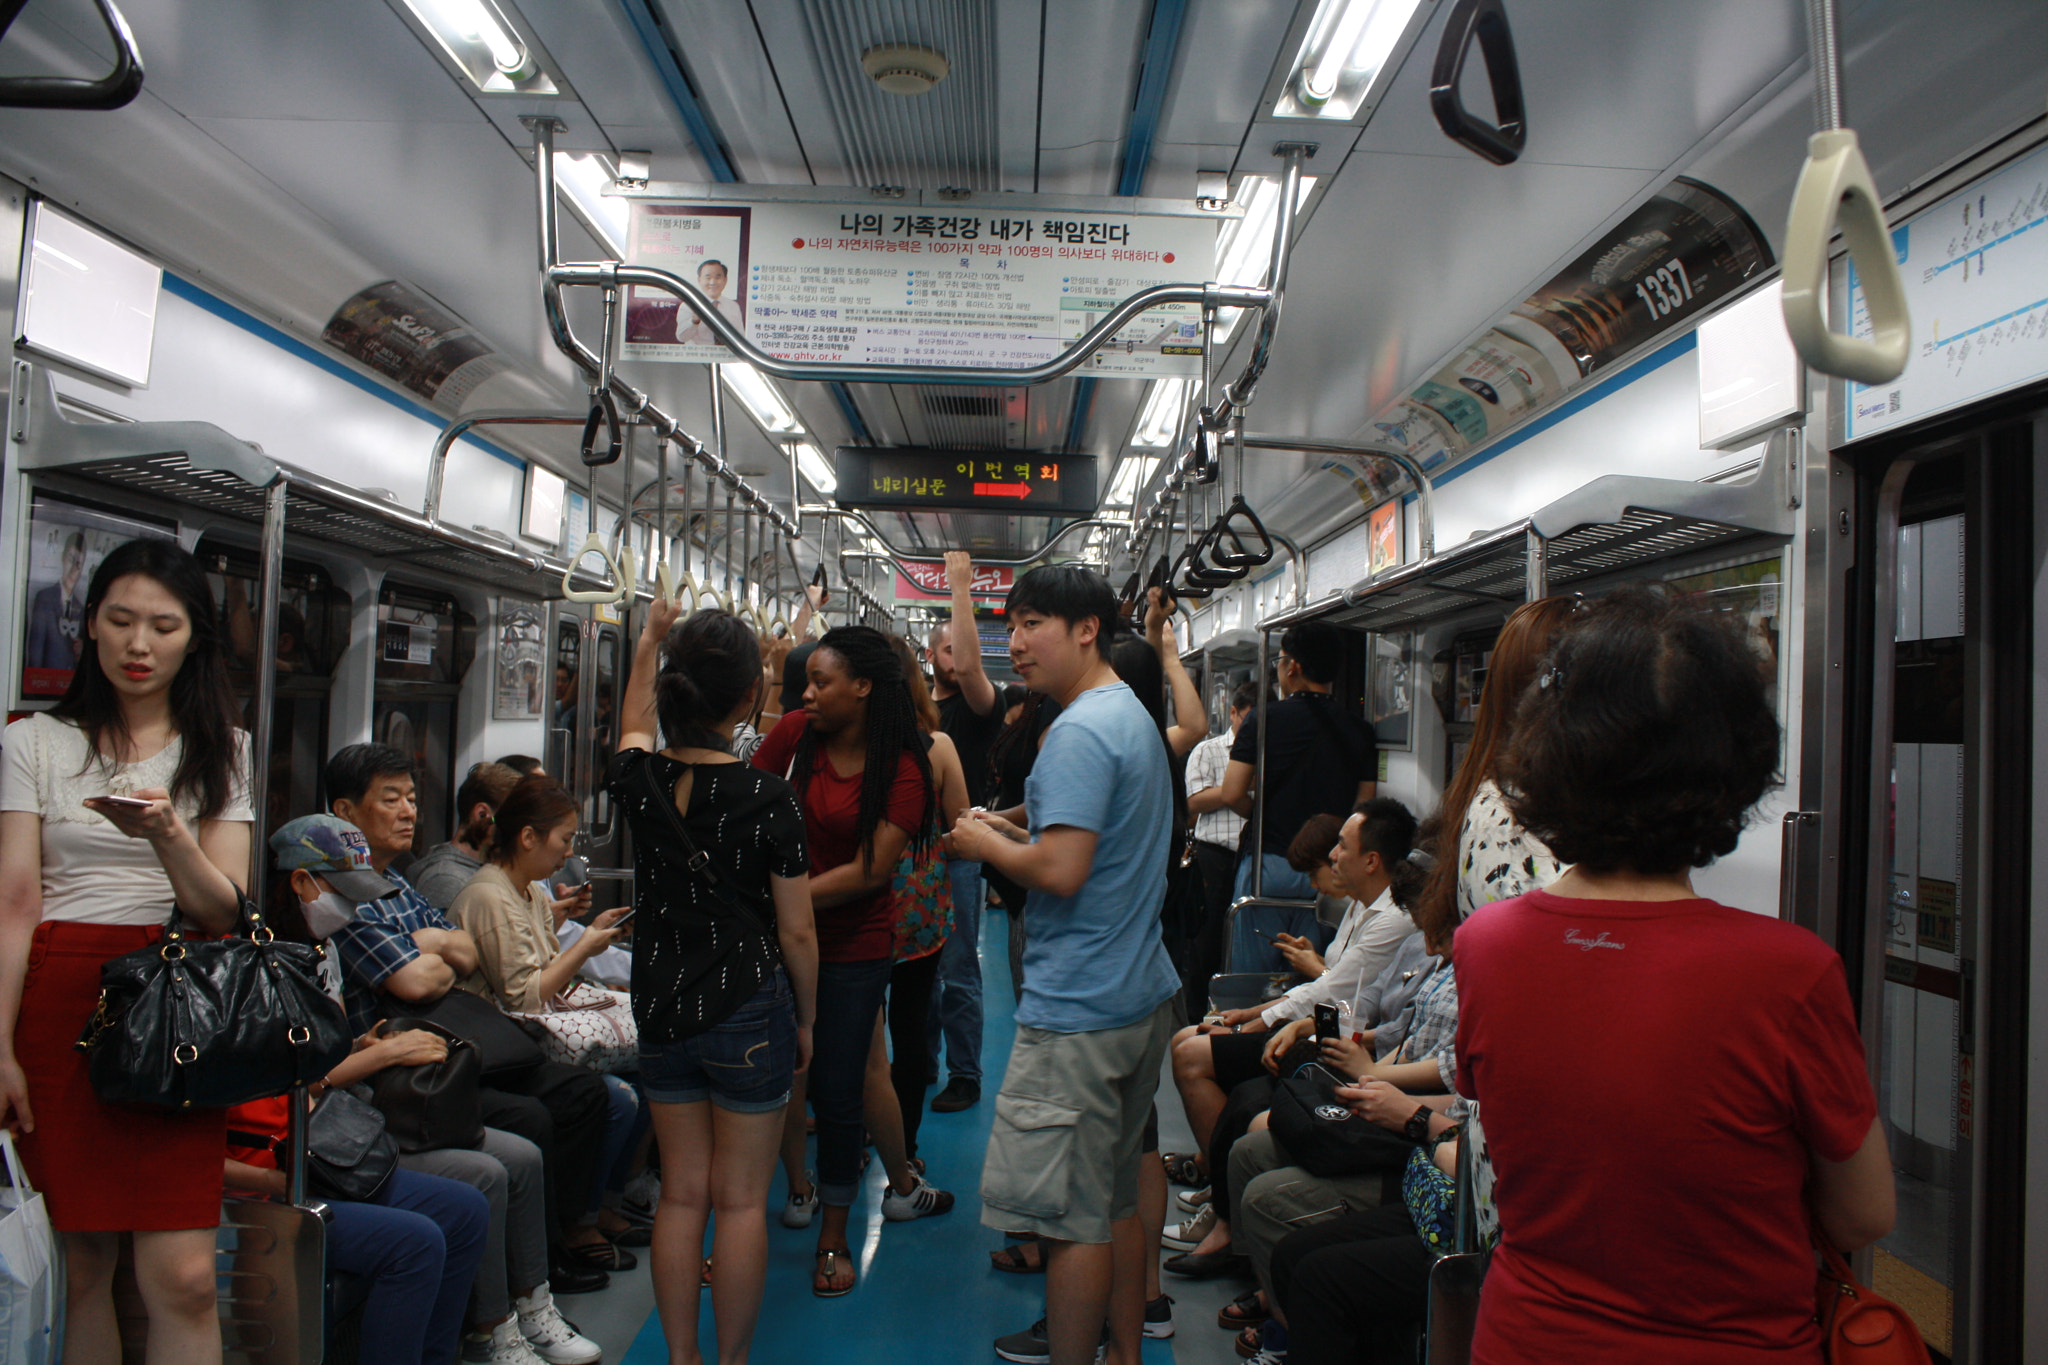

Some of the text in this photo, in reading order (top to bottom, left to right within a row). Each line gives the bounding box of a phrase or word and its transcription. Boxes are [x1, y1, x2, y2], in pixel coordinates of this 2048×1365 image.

[840, 213, 1130, 246] 나의 가족건강 내가 책임진다
[808, 237, 1159, 263] 나의 자연치유능력은 100가지 약과 100명의 의사보다 위대하다
[954, 271, 978, 281] 72시간
[981, 272, 1000, 281] 100%
[1635, 257, 1695, 321] 1337
[791, 308, 818, 319] 박세준
[820, 308, 839, 320] 약력
[768, 351, 843, 361] www.ghtv.or.kr
[873, 477, 947, 496] 내리실문
[1959, 1077, 1973, 1136] 손잡이
